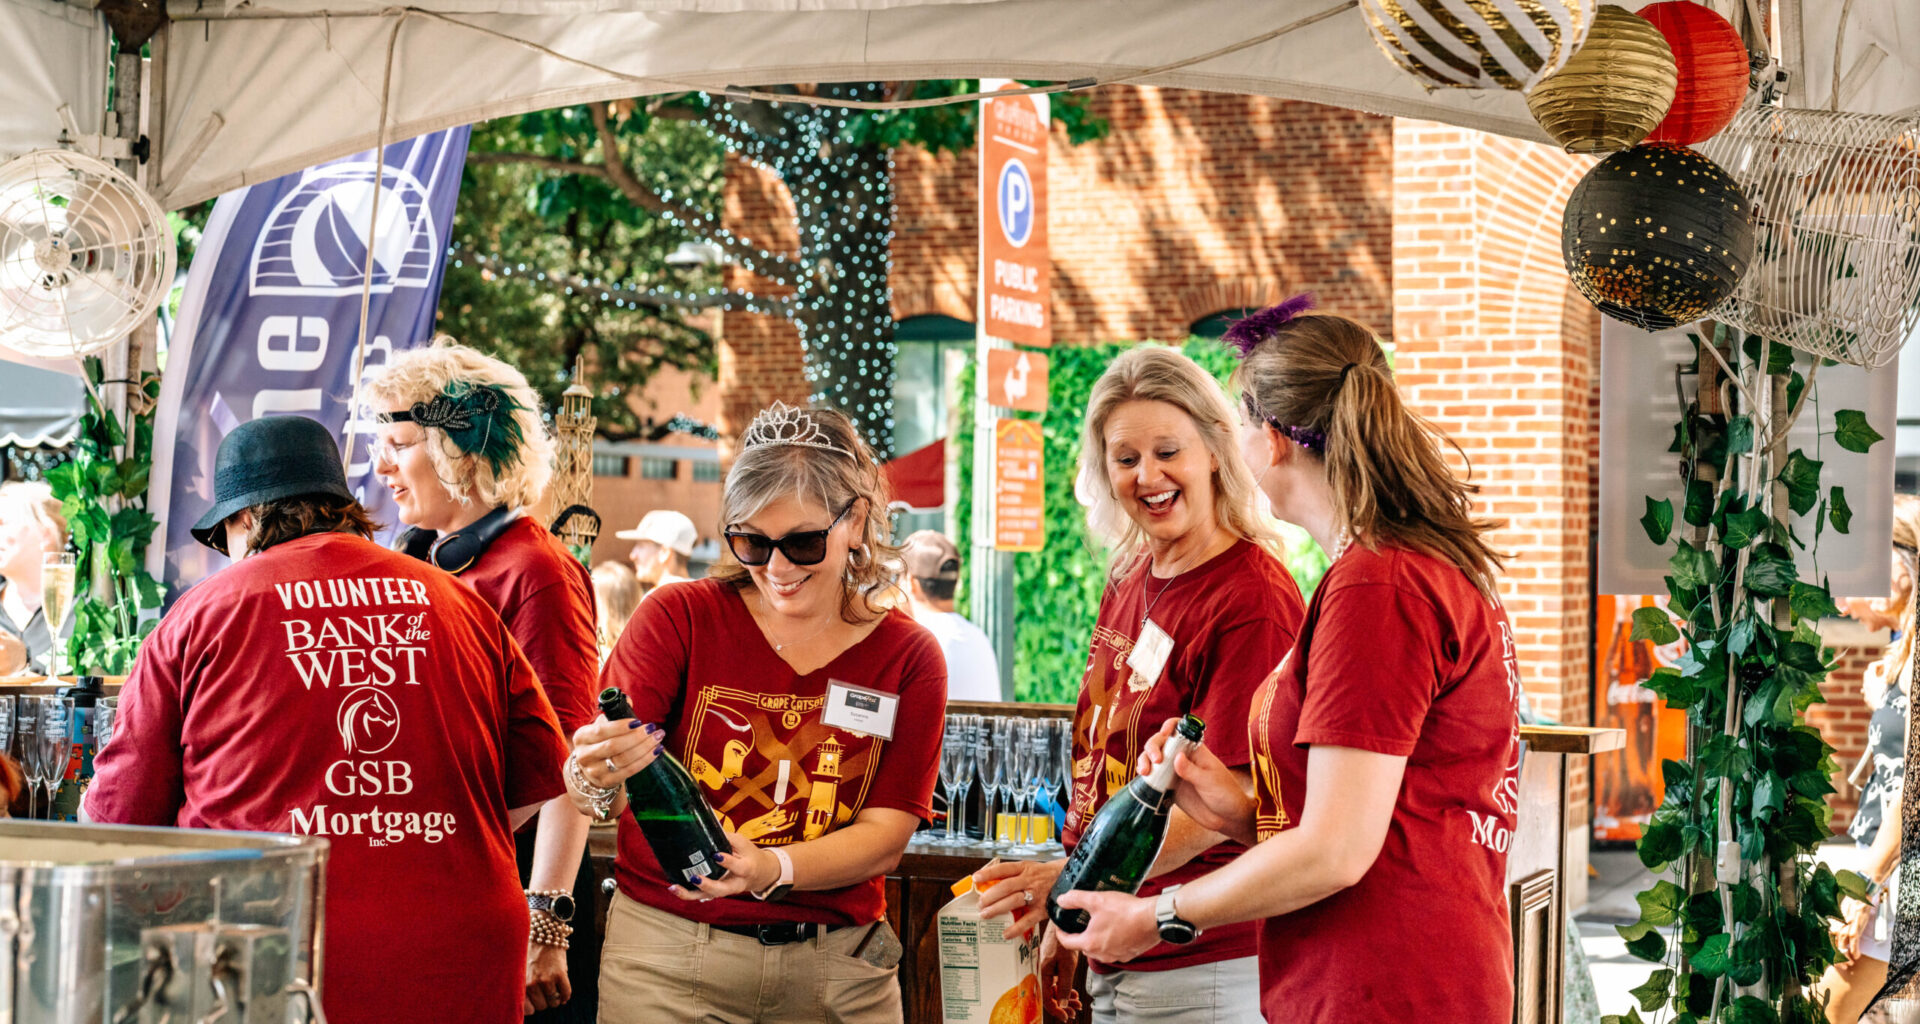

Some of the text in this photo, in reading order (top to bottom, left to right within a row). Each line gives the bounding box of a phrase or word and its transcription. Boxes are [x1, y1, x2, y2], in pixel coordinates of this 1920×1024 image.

[1007, 171, 1027, 233] P
[994, 258, 1038, 293] PUBLIC
[990, 294, 1044, 329] PARKING
[274, 577, 430, 610] VOLUNTEER
[280, 611, 427, 652] BANK of
[404, 626, 431, 641] the
[285, 647, 427, 690] WEST
[760, 696, 789, 709] GRAPE
[324, 760, 413, 797] GSB
[288, 804, 456, 844] Mortgage
[368, 836, 388, 848] Inc.
